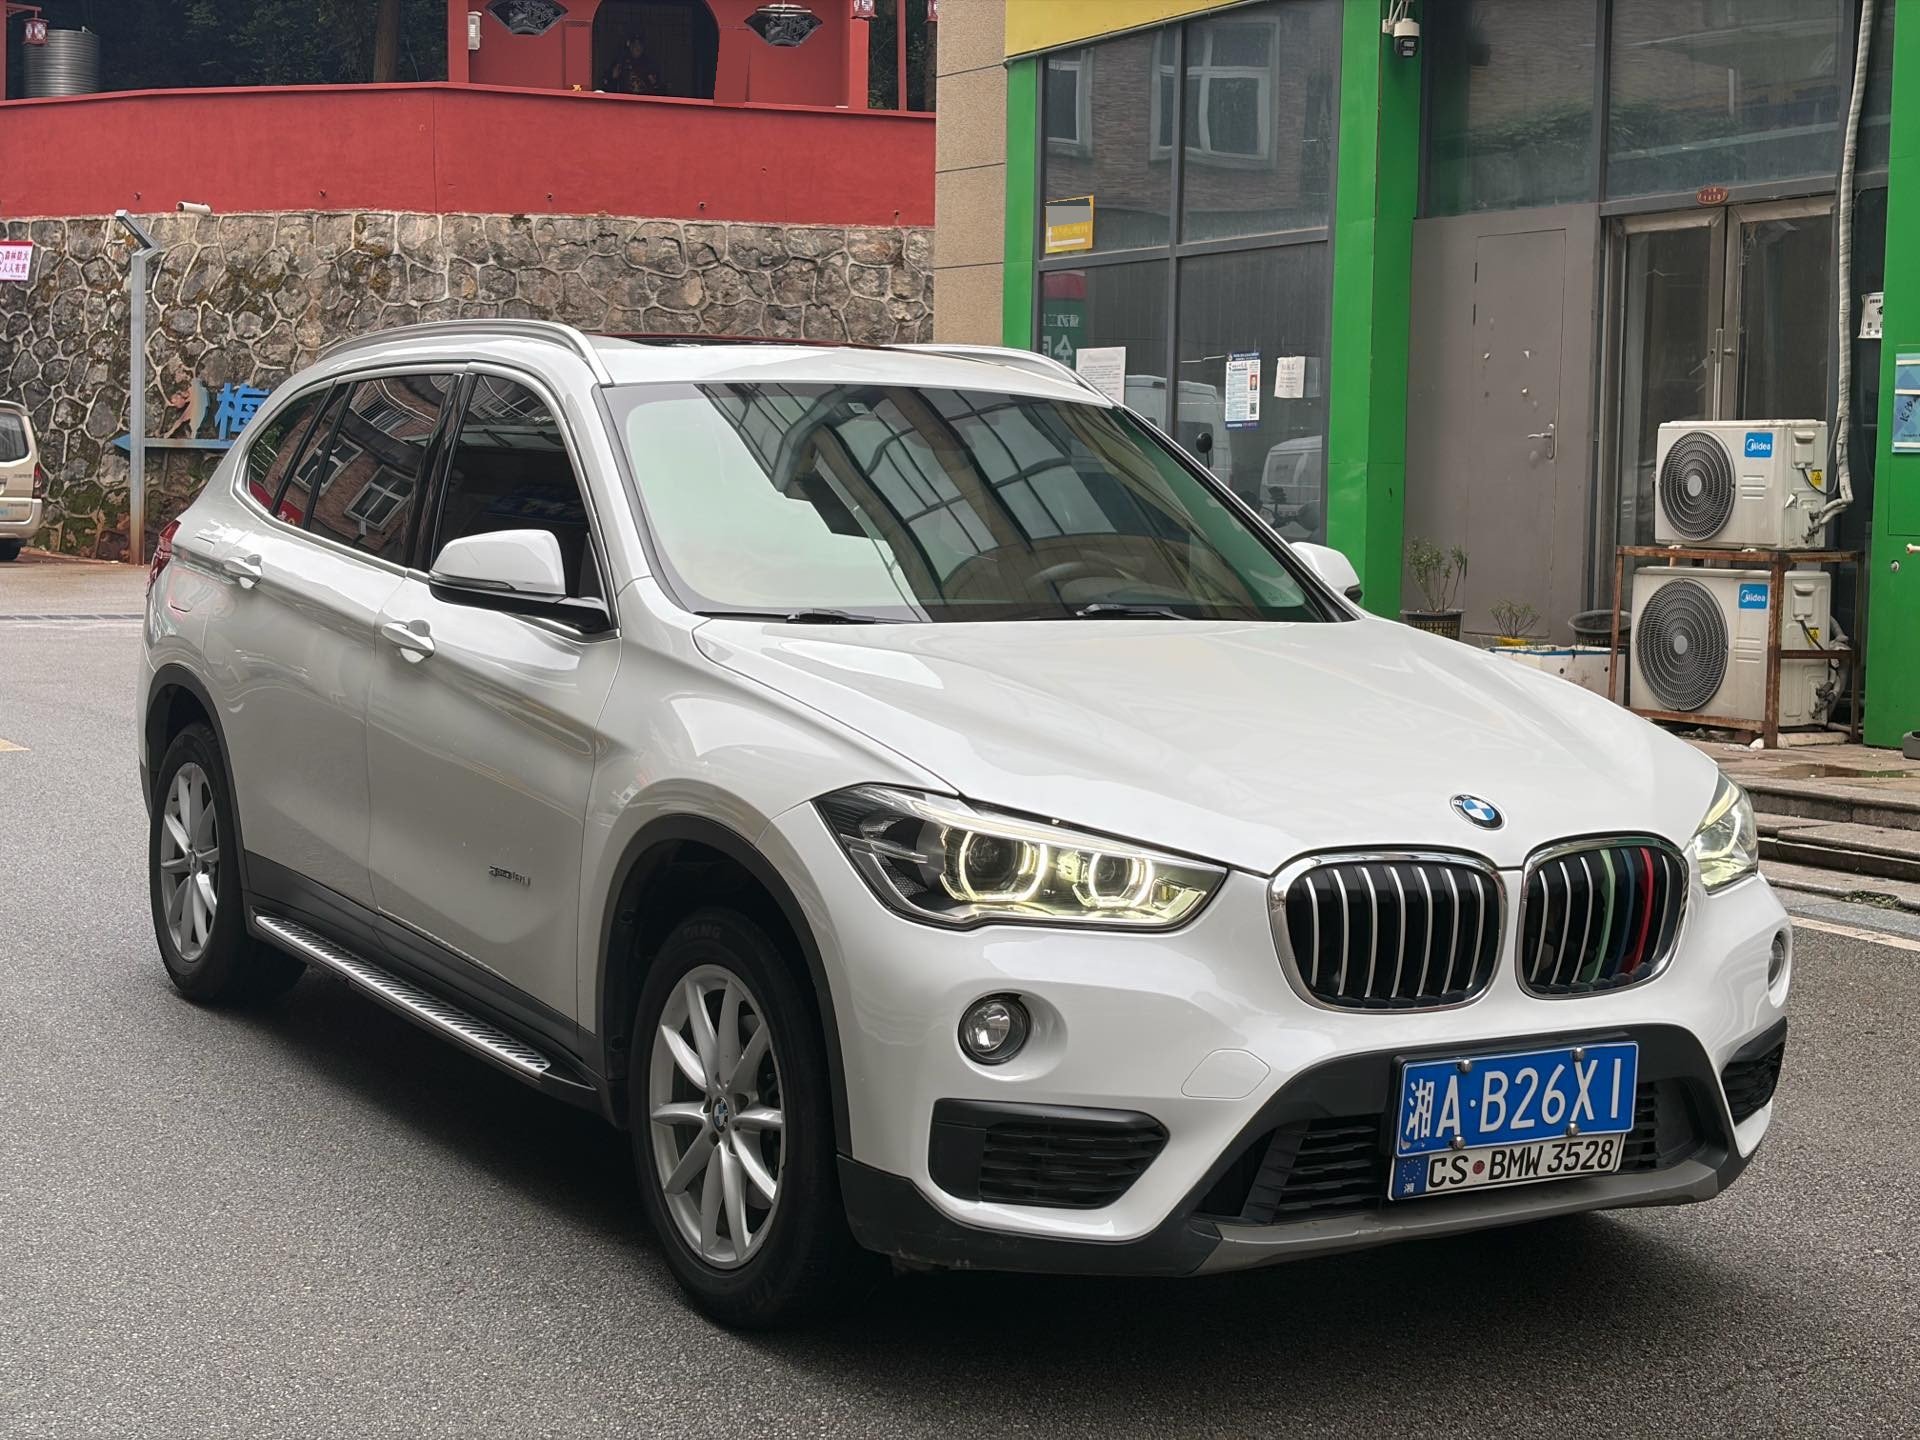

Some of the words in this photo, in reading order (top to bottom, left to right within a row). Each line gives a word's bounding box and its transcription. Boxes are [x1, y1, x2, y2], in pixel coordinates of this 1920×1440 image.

[1746, 438, 1771, 451] Midea
[1740, 588, 1766, 603] Midea
[1428, 1154, 1469, 1188] CS
[1487, 1145, 1544, 1181] BMW
[1546, 1139, 1615, 1173] 3528
